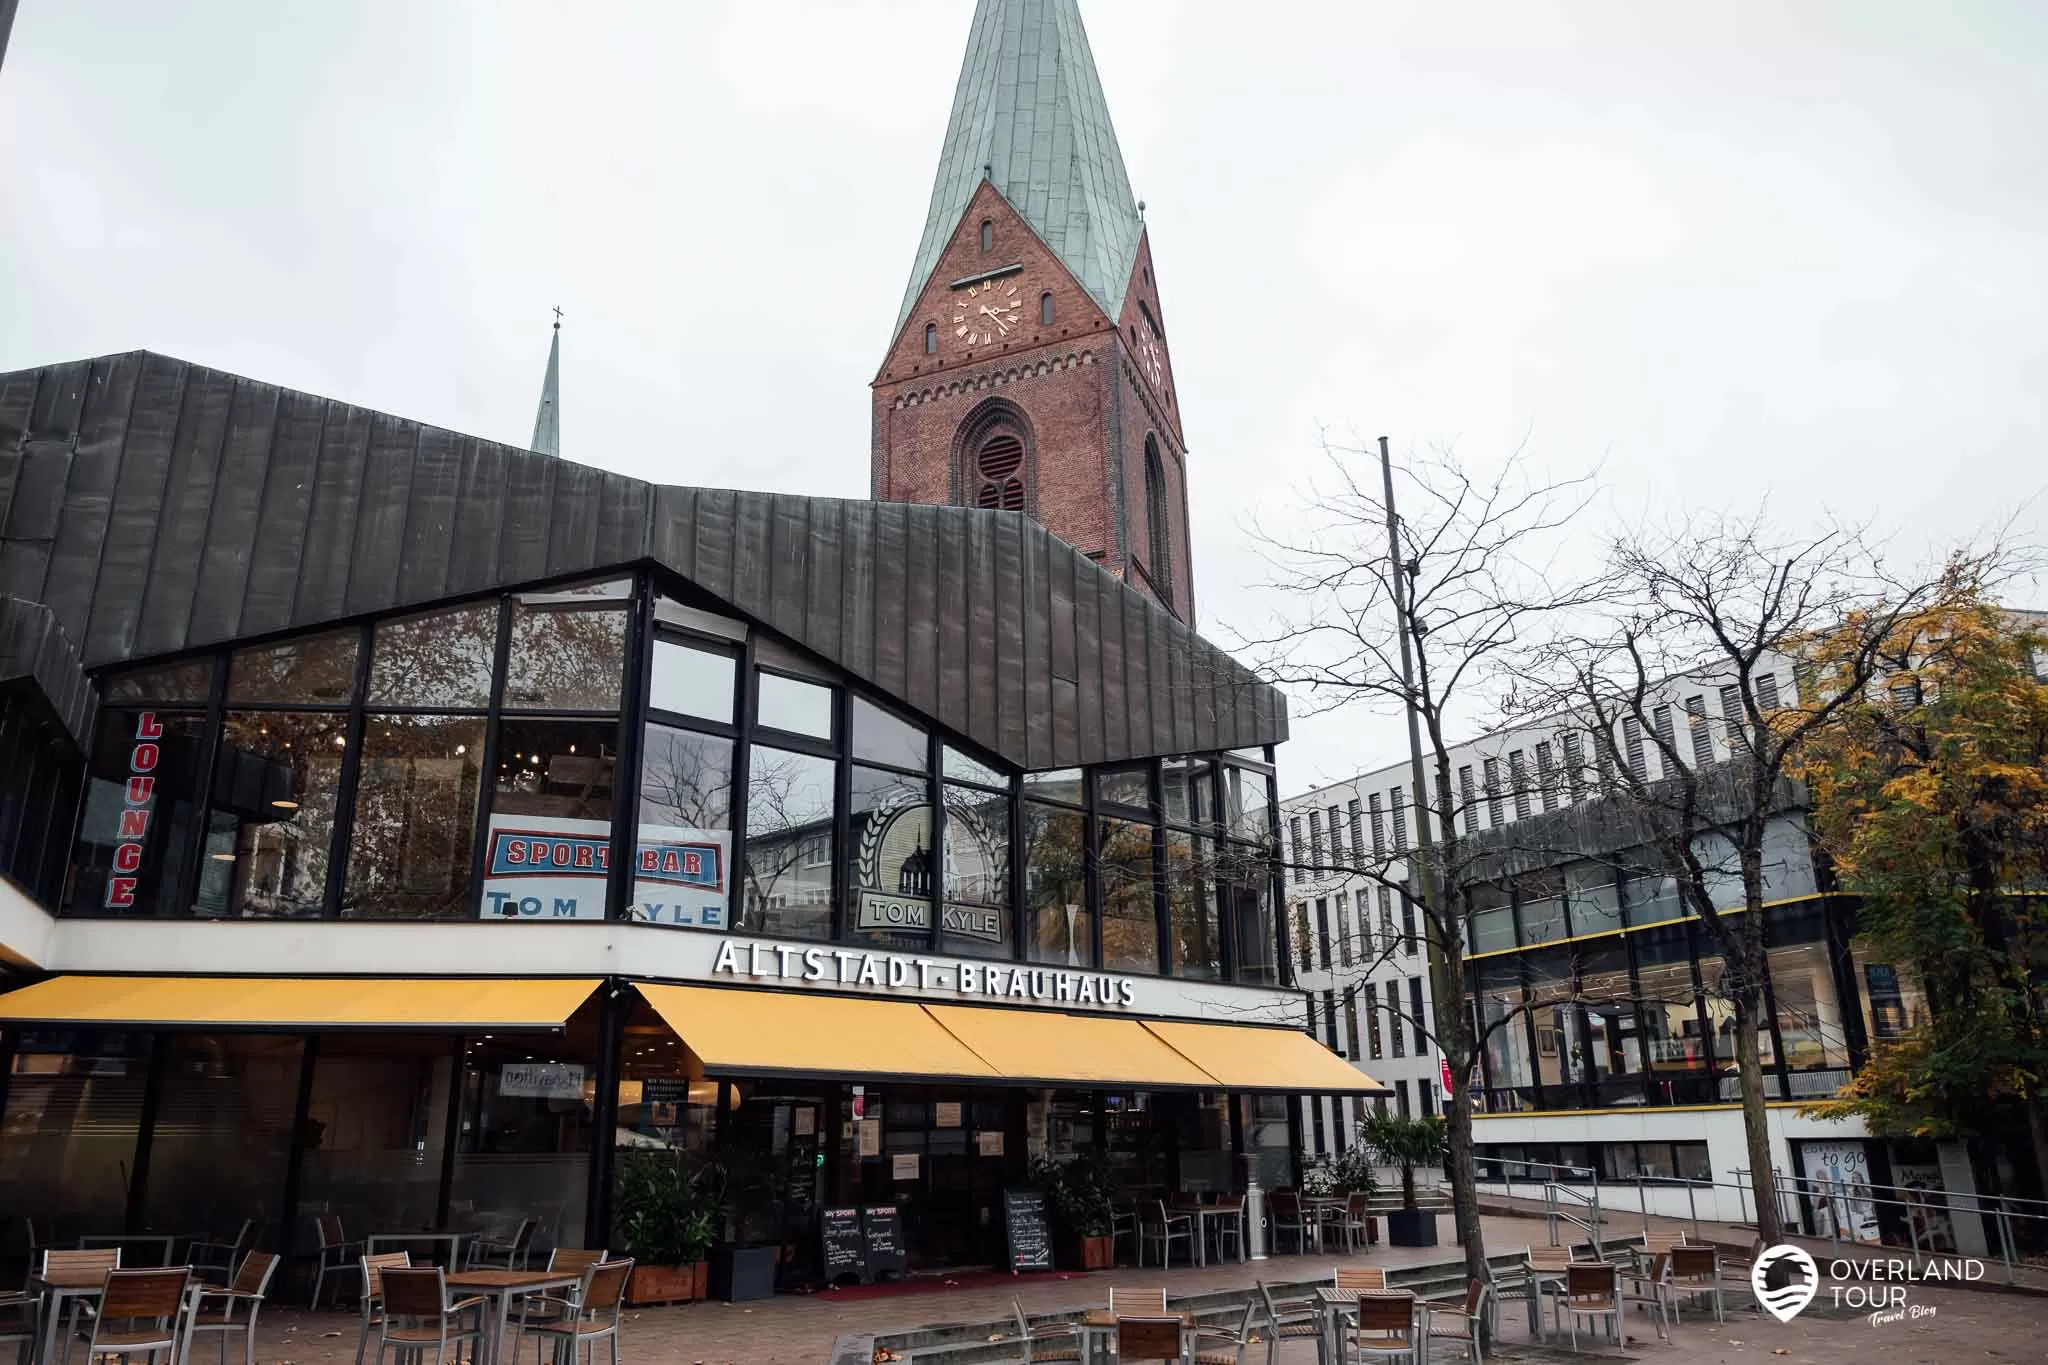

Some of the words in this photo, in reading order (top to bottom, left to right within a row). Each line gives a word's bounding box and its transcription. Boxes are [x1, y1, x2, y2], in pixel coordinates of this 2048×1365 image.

[104, 711, 163, 908] LOUNGE
[640, 848, 702, 875] BAR
[486, 891, 577, 917] TOM
[644, 903, 721, 925] YLE
[870, 900, 925, 926] TOM
[942, 903, 997, 932] KYLE
[1821, 1152, 1838, 1167] to
[1844, 1151, 1865, 1173] go
